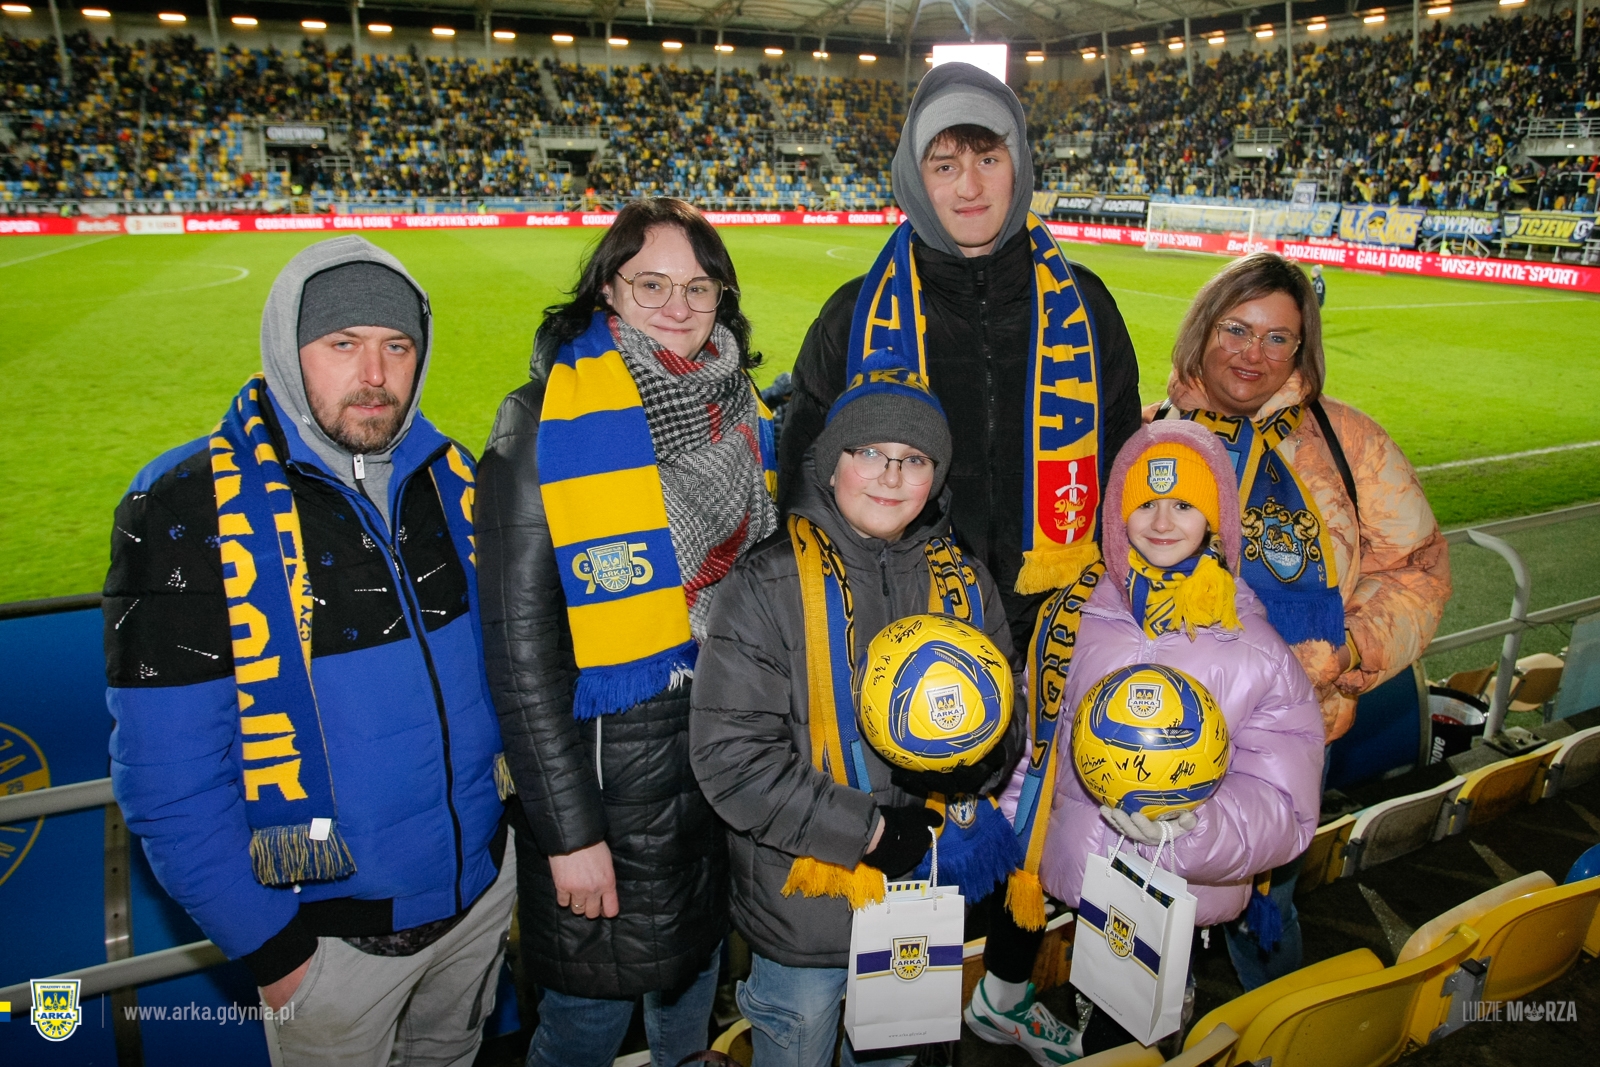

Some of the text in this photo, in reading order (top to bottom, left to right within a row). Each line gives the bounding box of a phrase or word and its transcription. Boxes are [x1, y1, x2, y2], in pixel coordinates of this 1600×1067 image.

[187, 218, 240, 231] Betclic
[254, 217, 325, 230] CODZIENNIE
[526, 214, 569, 226] Betclic
[802, 214, 839, 224] Betclic
[1083, 226, 1102, 239] CAŁĄ
[1517, 217, 1577, 239] TCZEW
[1226, 239, 1270, 254] Betclic
[1283, 243, 1347, 263] CODZIENNIE
[1356, 250, 1388, 269] CAŁĄ
[1388, 253, 1424, 272] DOBĘ
[602, 569, 627, 578] ARKA
[299, 605, 312, 642] CZY
[936, 709, 960, 718] ARKA
[1109, 930, 1129, 947] ARKA
[897, 958, 923, 967] ARKA
